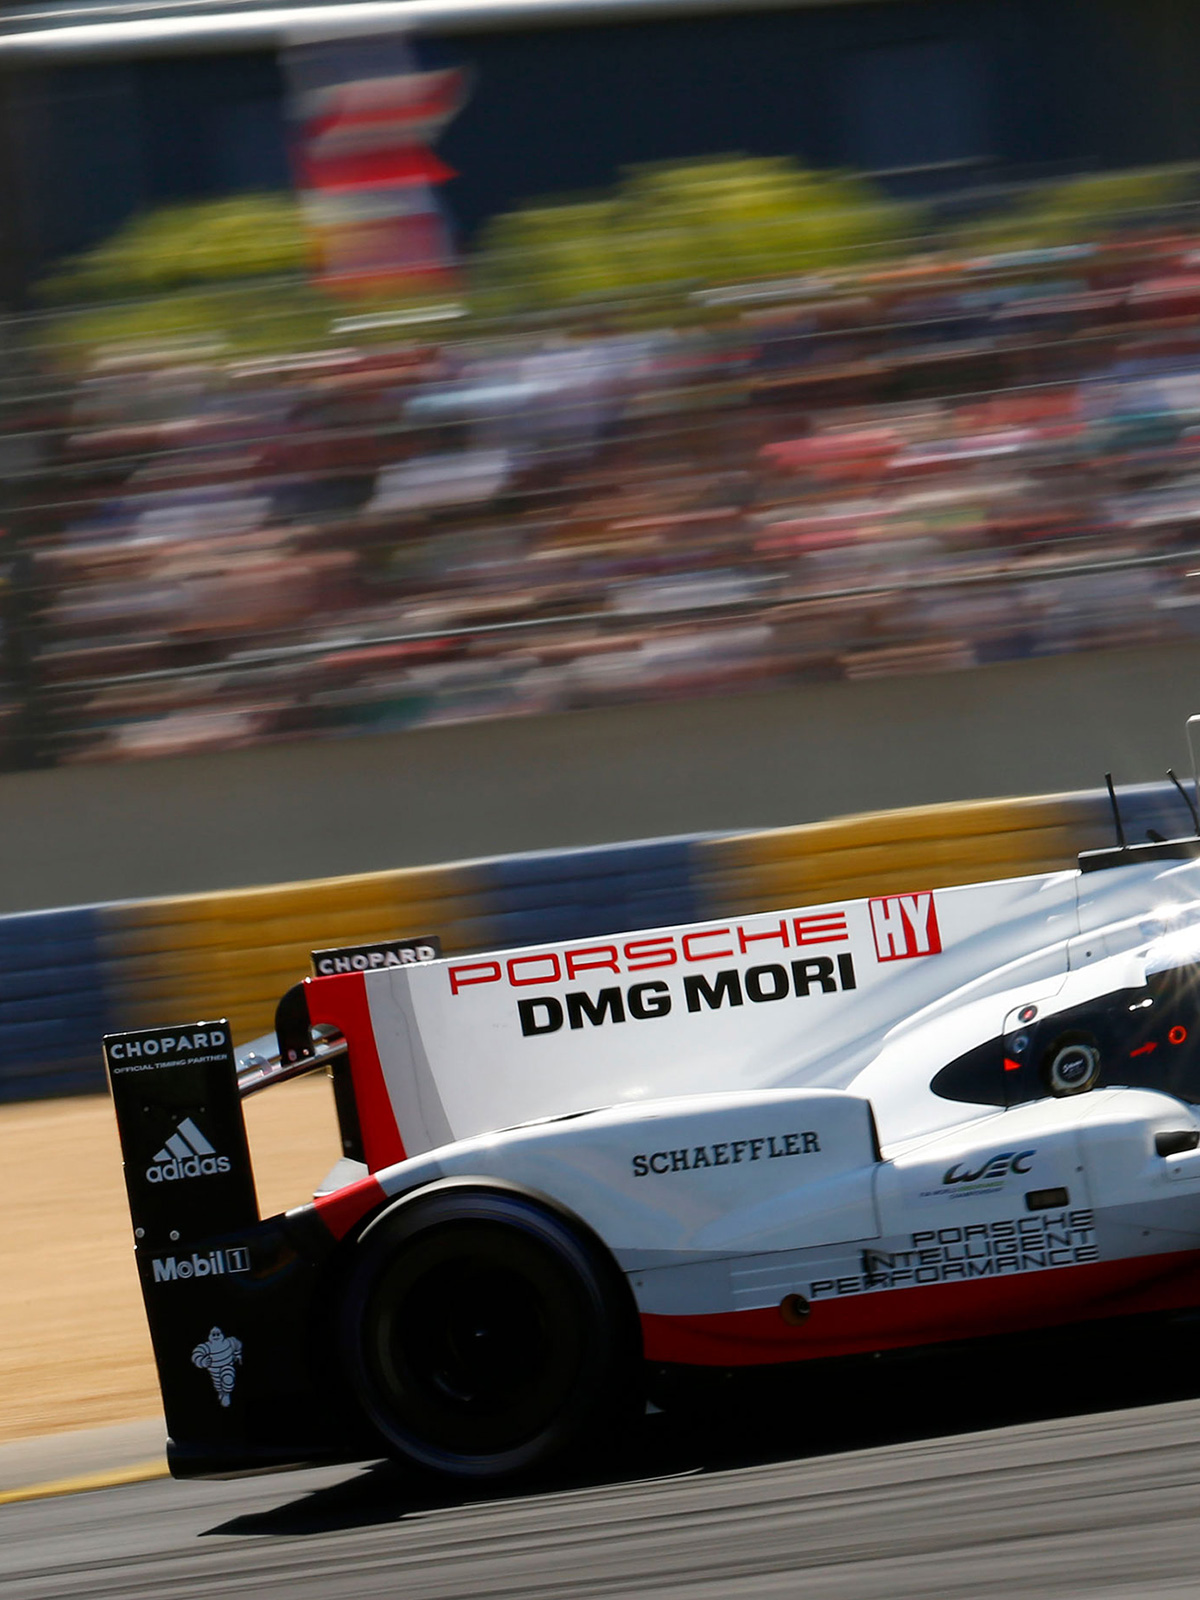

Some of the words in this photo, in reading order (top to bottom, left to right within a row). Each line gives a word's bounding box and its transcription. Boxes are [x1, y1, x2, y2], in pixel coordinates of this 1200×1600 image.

[869, 890, 942, 963] HY
[318, 945, 436, 974] CHOPARD
[448, 911, 850, 996] PORSCHE
[517, 980, 672, 1038] DMG
[683, 952, 857, 1014] MORI
[110, 1030, 226, 1060] CHOPARD
[113, 1064, 155, 1075] OFFICIAL
[155, 1059, 187, 1069] TIMING
[187, 1054, 228, 1066] PARTNER
[145, 1154, 232, 1183] adidas
[632, 1130, 822, 1177] SCHAEFFLER
[942, 1149, 1038, 1185] WEC
[912, 1208, 1094, 1248] PORSCHE
[151, 1250, 225, 1283] Mobil
[809, 1244, 1100, 1298] PERFORMANCE
